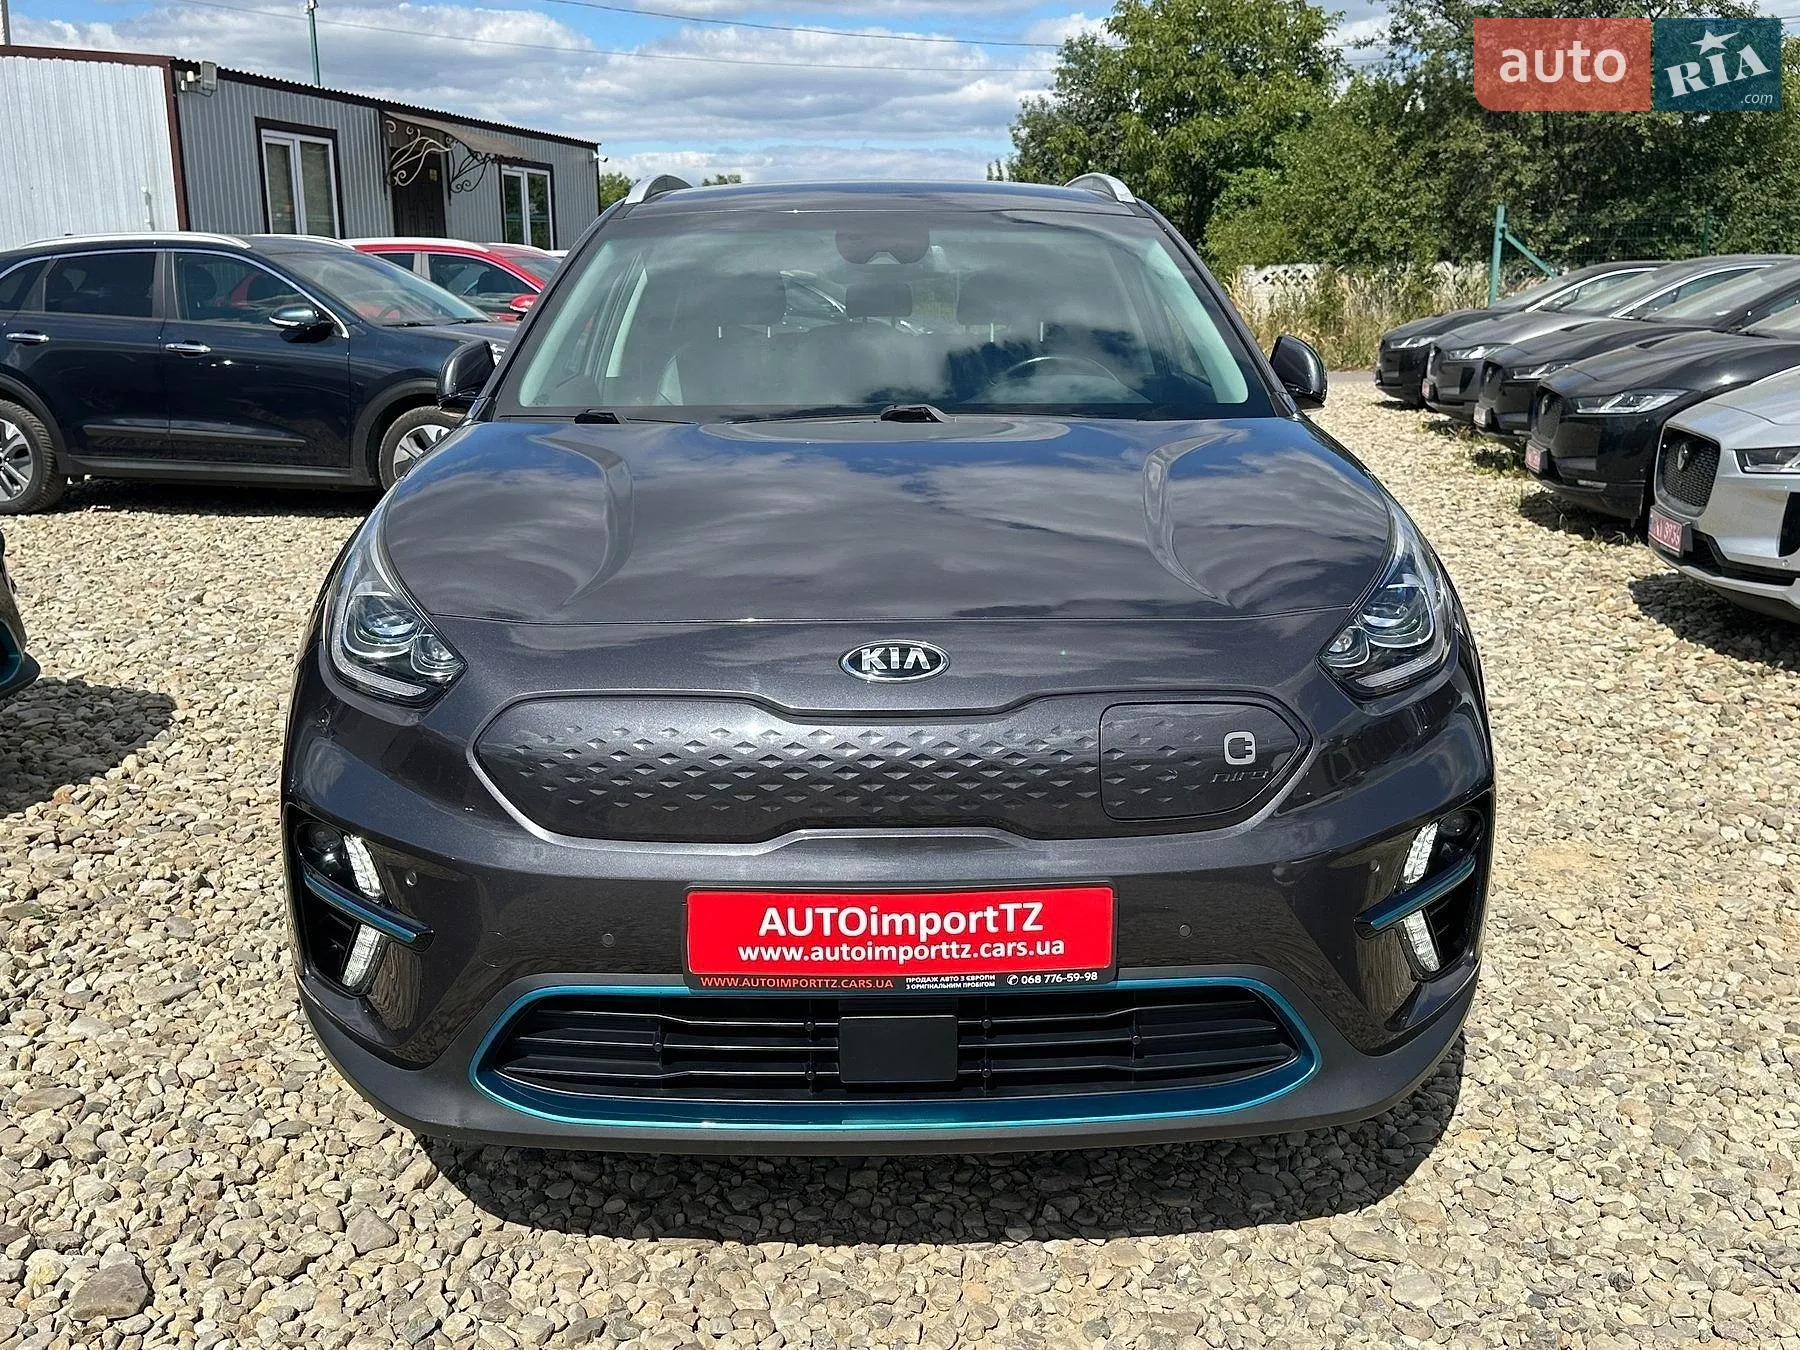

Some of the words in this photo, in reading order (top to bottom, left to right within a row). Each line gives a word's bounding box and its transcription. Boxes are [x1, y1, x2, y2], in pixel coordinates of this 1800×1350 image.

[860, 647, 931, 670] KIA
[758, 902, 1044, 942] AUTOimportTZ
[738, 939, 1065, 965] www.autoimporttz.cars.ua
[700, 977, 894, 989] WWW.AUTOIMPORTTZ.CARS.UA
[905, 976, 939, 984] ПРОДАЖ
[1020, 974, 1042, 985] 068
[1043, 971, 1098, 984] 776-59-98
